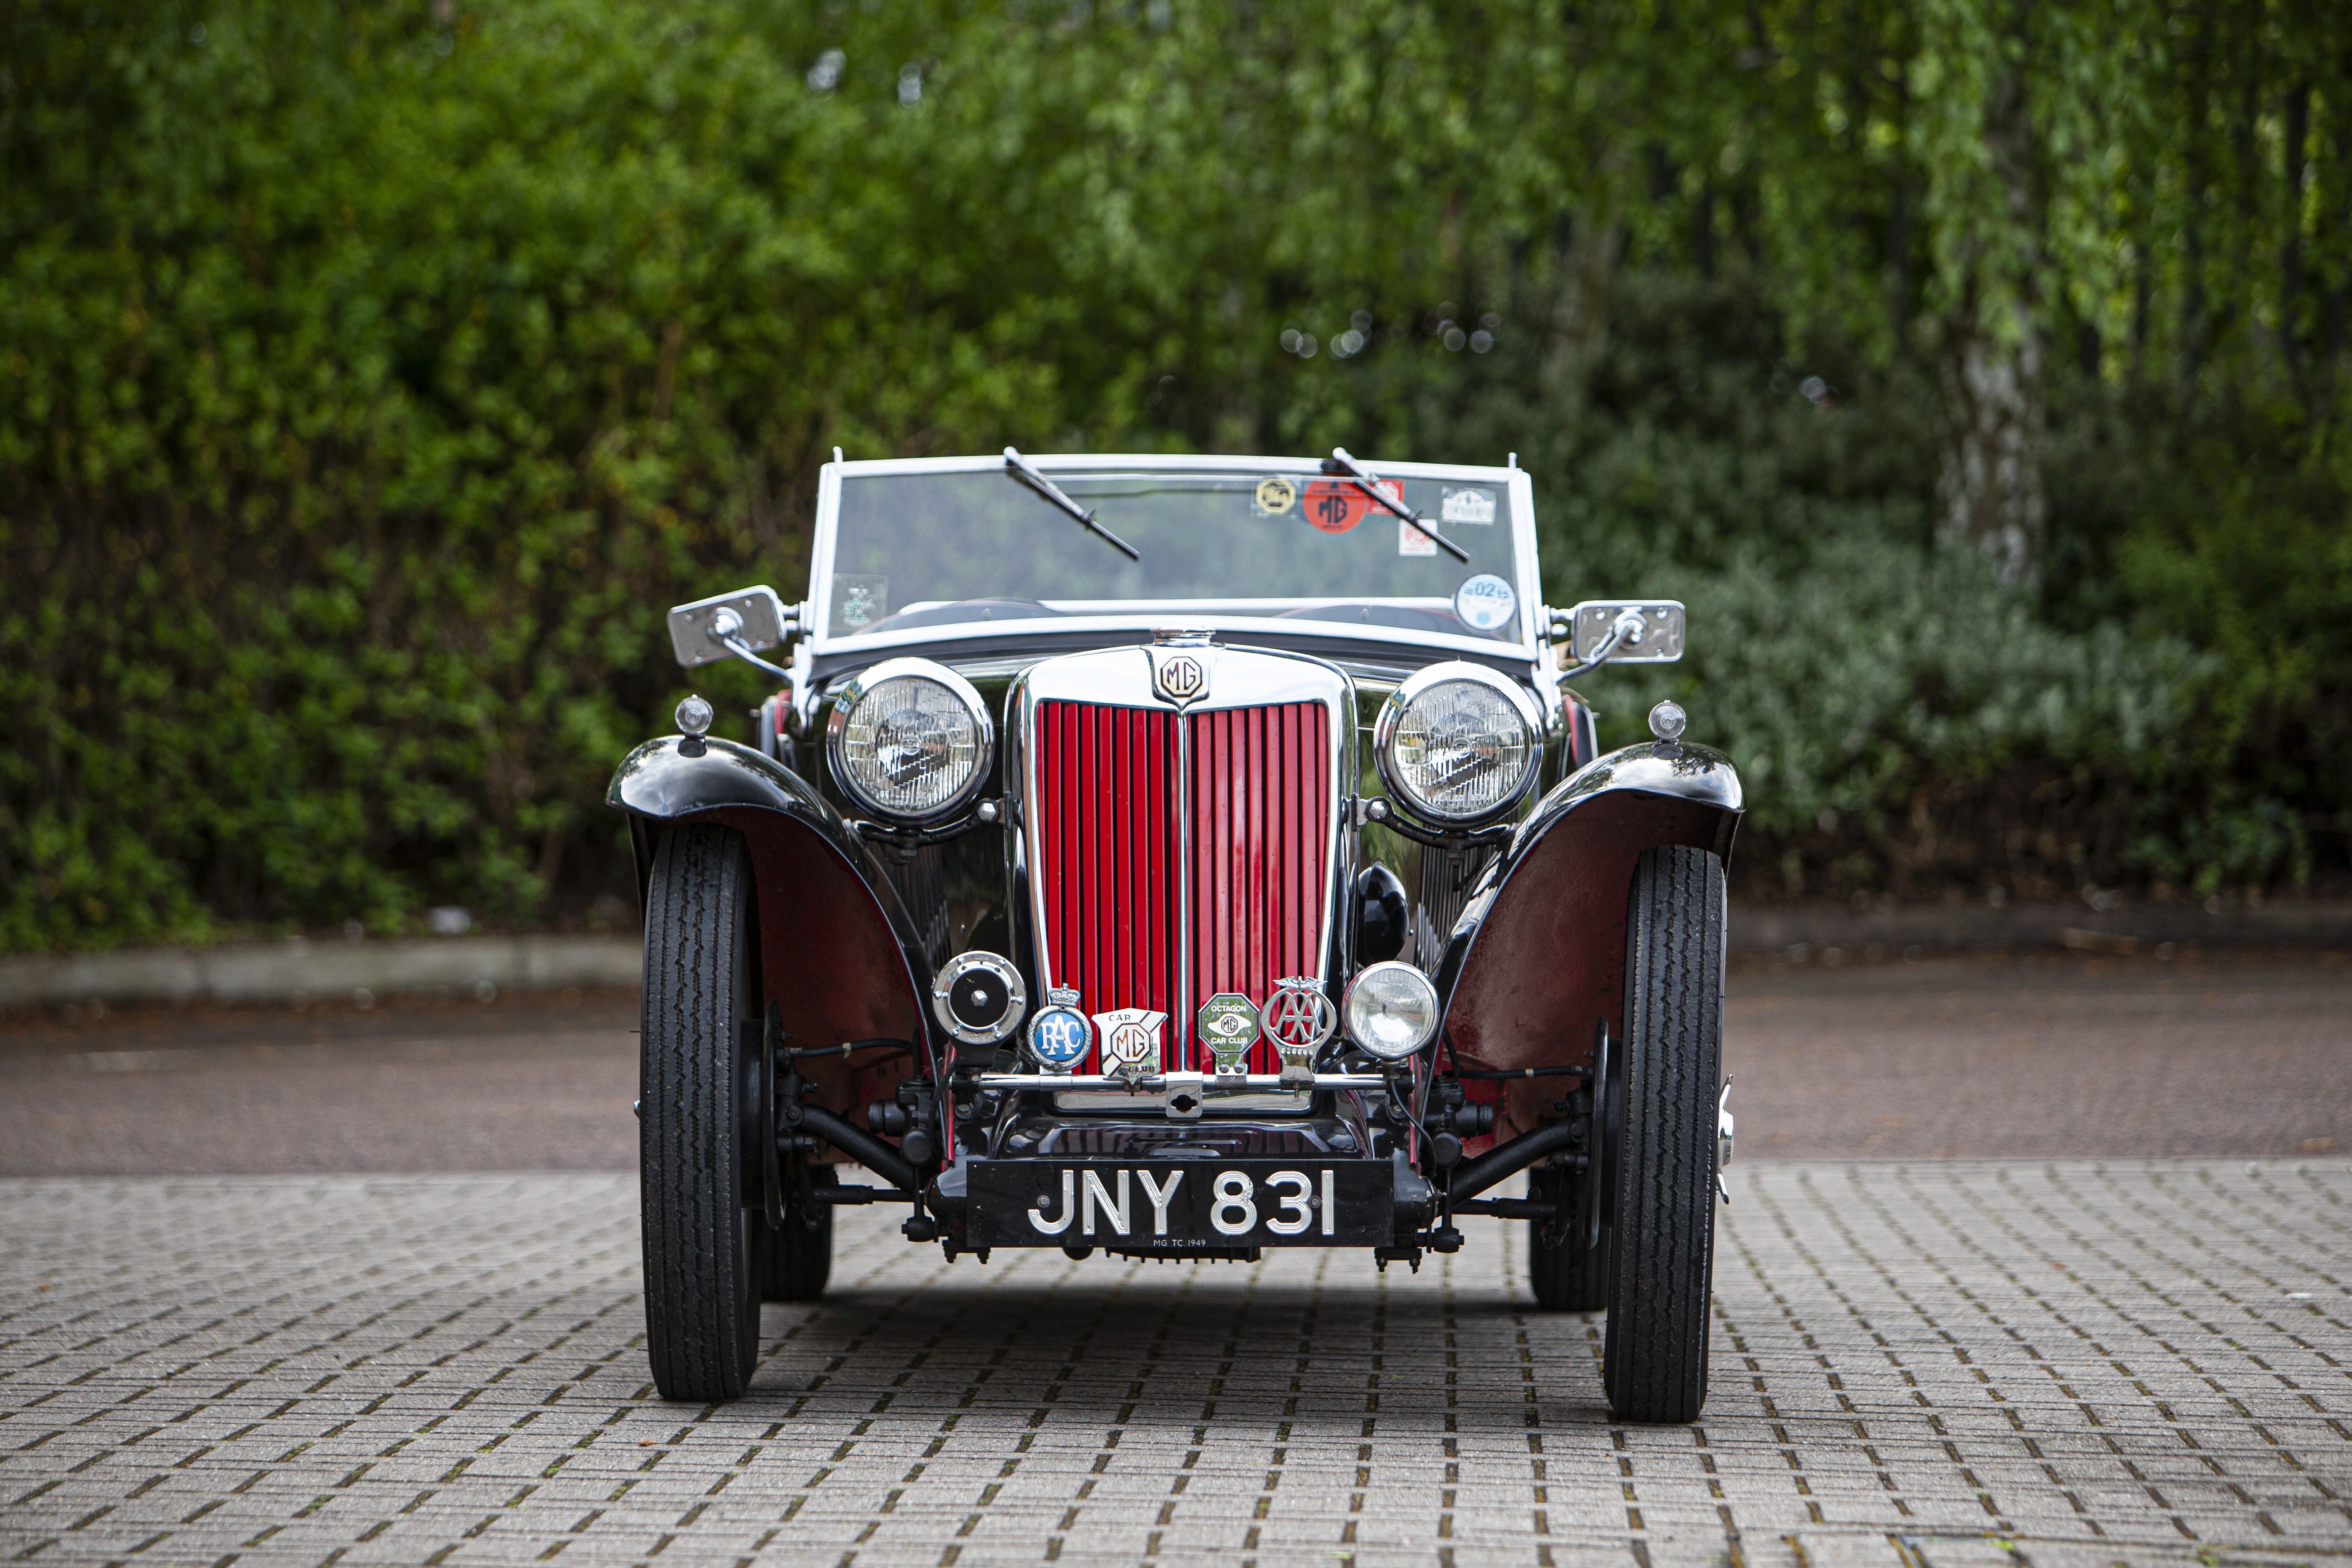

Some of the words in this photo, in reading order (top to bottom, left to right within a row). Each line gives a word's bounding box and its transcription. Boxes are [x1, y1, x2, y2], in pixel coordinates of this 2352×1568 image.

[1318, 495, 1347, 524] MG
[1475, 582, 1495, 597] 02
[1166, 662, 1196, 690] MG
[1223, 1018, 1236, 1031] MG
[1269, 992, 1327, 1043] AA
[1040, 1014, 1081, 1055] RAC
[1117, 1029, 1145, 1058] MG
[1028, 1169, 1185, 1235] JNY
[1210, 1170, 1335, 1235] 831
